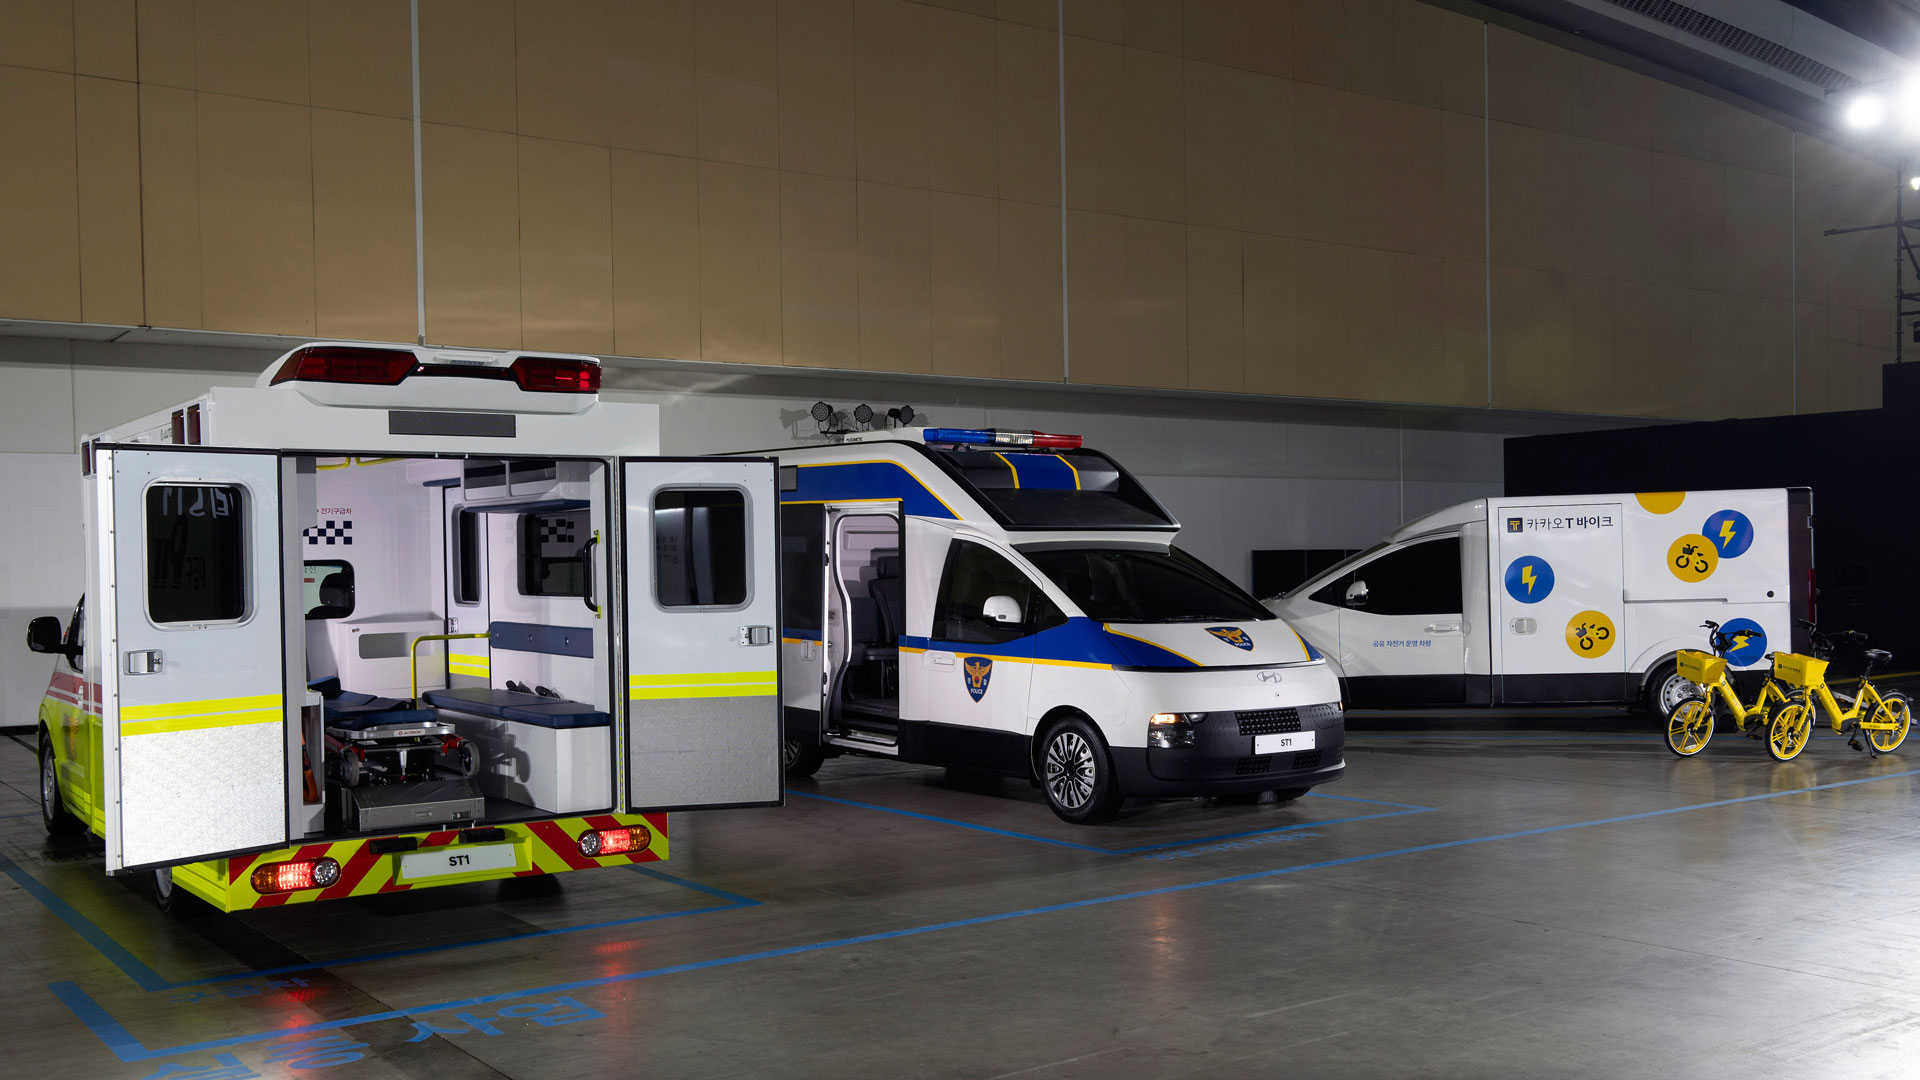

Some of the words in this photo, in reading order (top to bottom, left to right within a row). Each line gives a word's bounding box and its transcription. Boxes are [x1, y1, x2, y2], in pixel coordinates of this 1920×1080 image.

[320, 507, 352, 515] 전기구급차
[1576, 515, 1614, 529] 바이크
[1372, 639, 1385, 648] 공유
[1386, 639, 1405, 648] 자전거
[1405, 639, 1418, 648] 운영
[1419, 639, 1432, 648] 차량
[1281, 738, 1292, 746] ST1
[449, 855, 470, 866] ST1
[406, 996, 607, 1043] 사업
